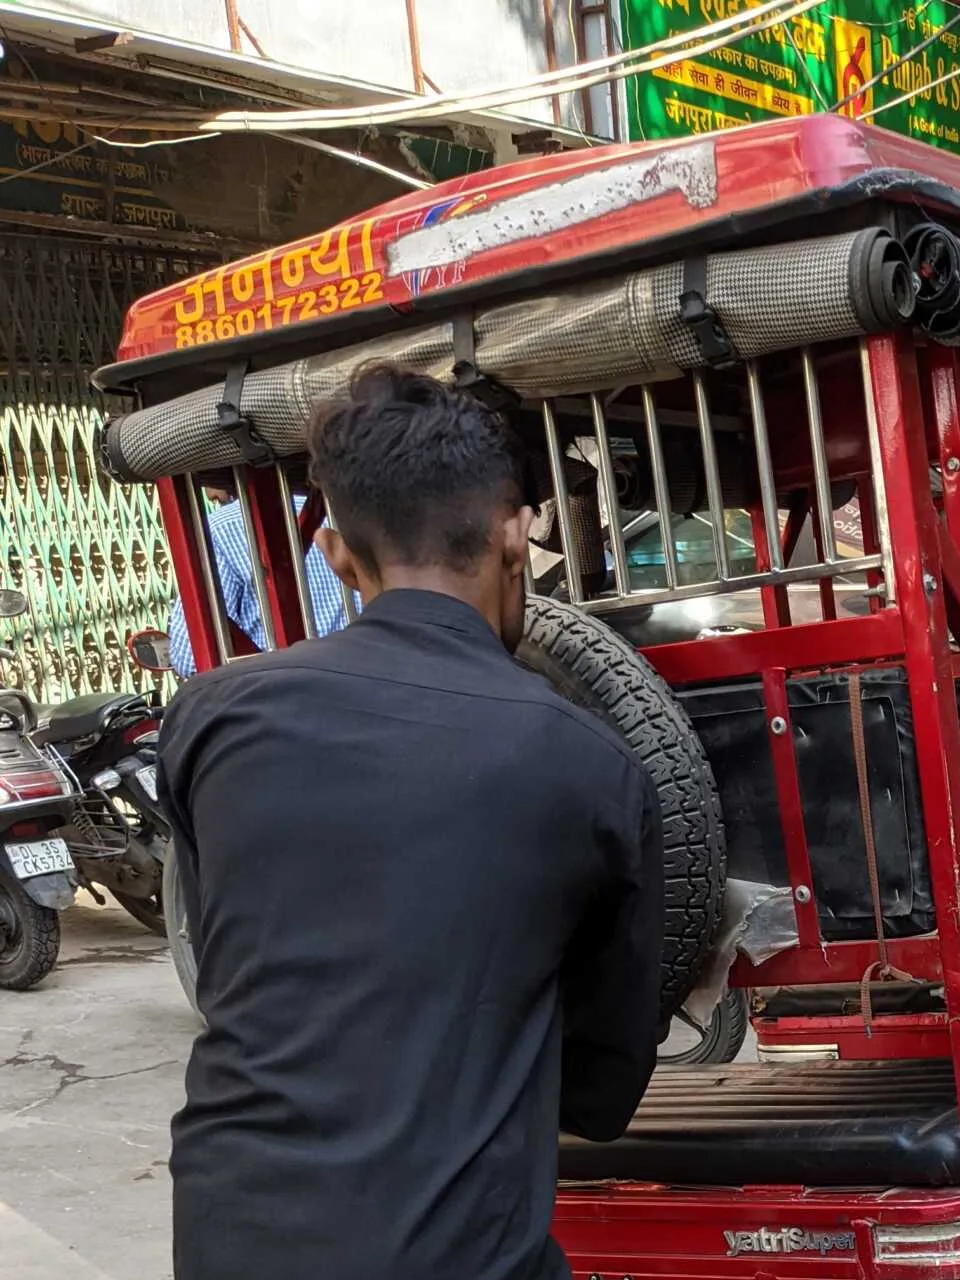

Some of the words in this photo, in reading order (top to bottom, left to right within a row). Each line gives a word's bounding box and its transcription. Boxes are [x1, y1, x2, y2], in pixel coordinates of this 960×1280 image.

[715, 73, 726, 93] ही
[881, 34, 933, 108] Punjab
[935, 56, 948, 108] &
[175, 272, 384, 350] 8860172322
